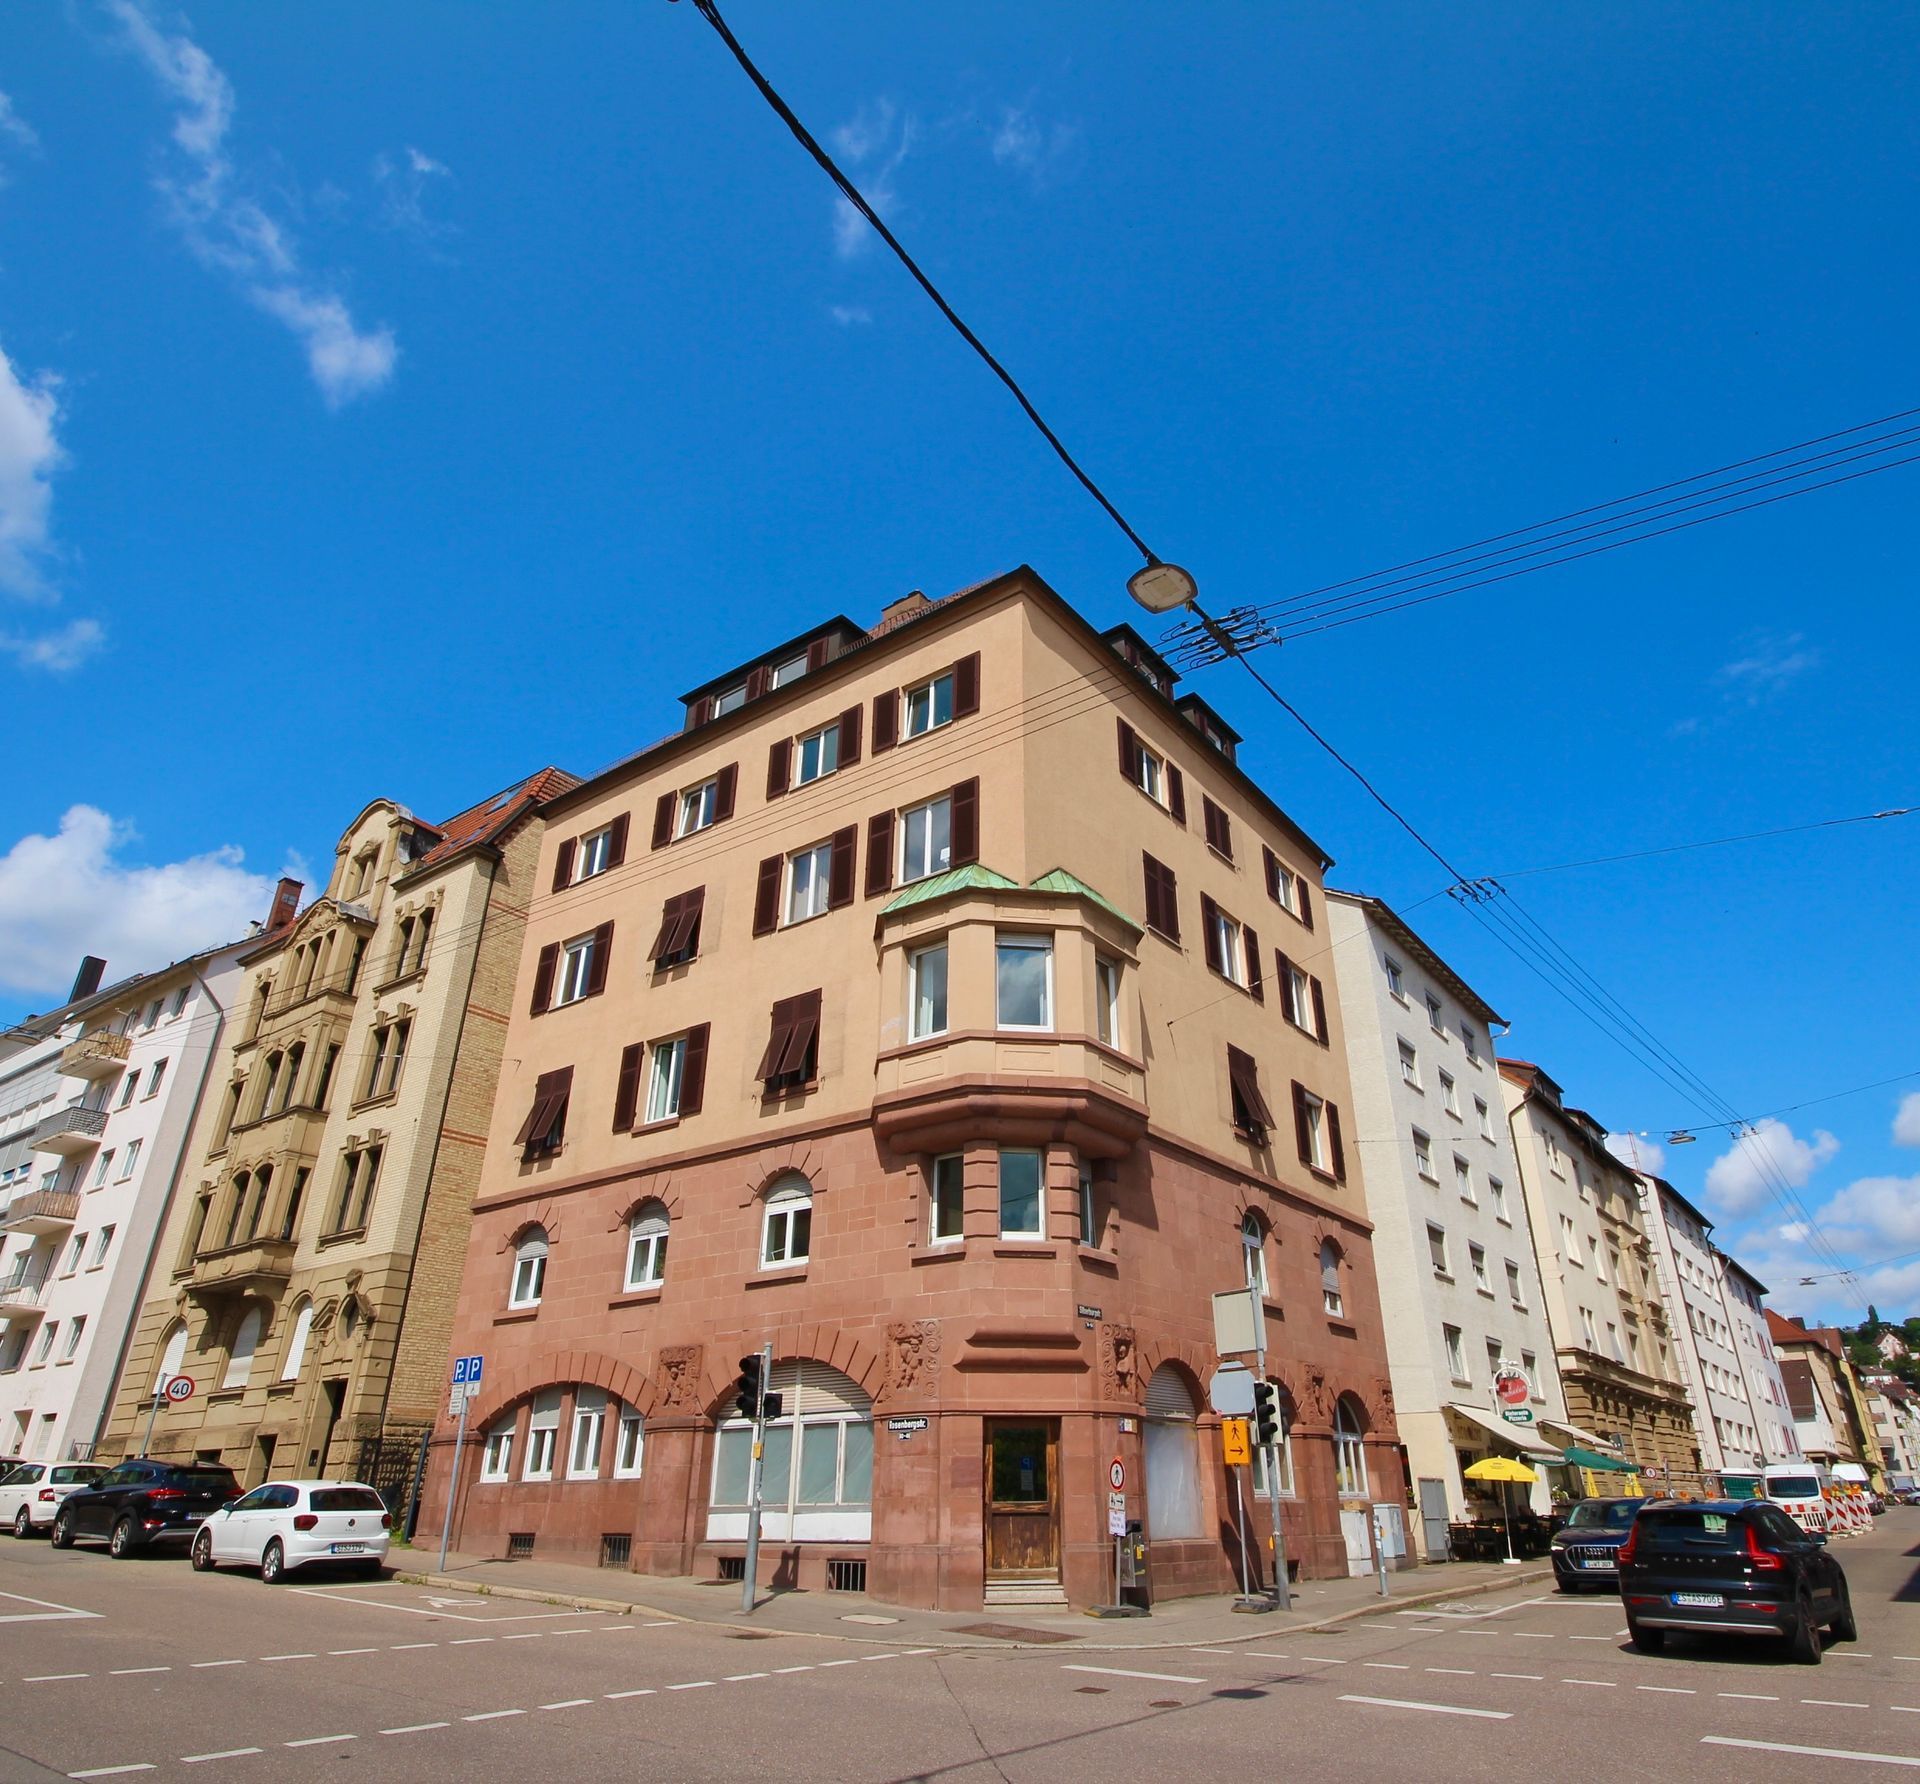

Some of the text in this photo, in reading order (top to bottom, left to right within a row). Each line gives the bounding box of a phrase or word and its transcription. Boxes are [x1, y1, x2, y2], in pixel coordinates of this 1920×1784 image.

[455, 1361, 464, 1381] P
[470, 1359, 480, 1379] P
[171, 1383, 190, 1396] 40
